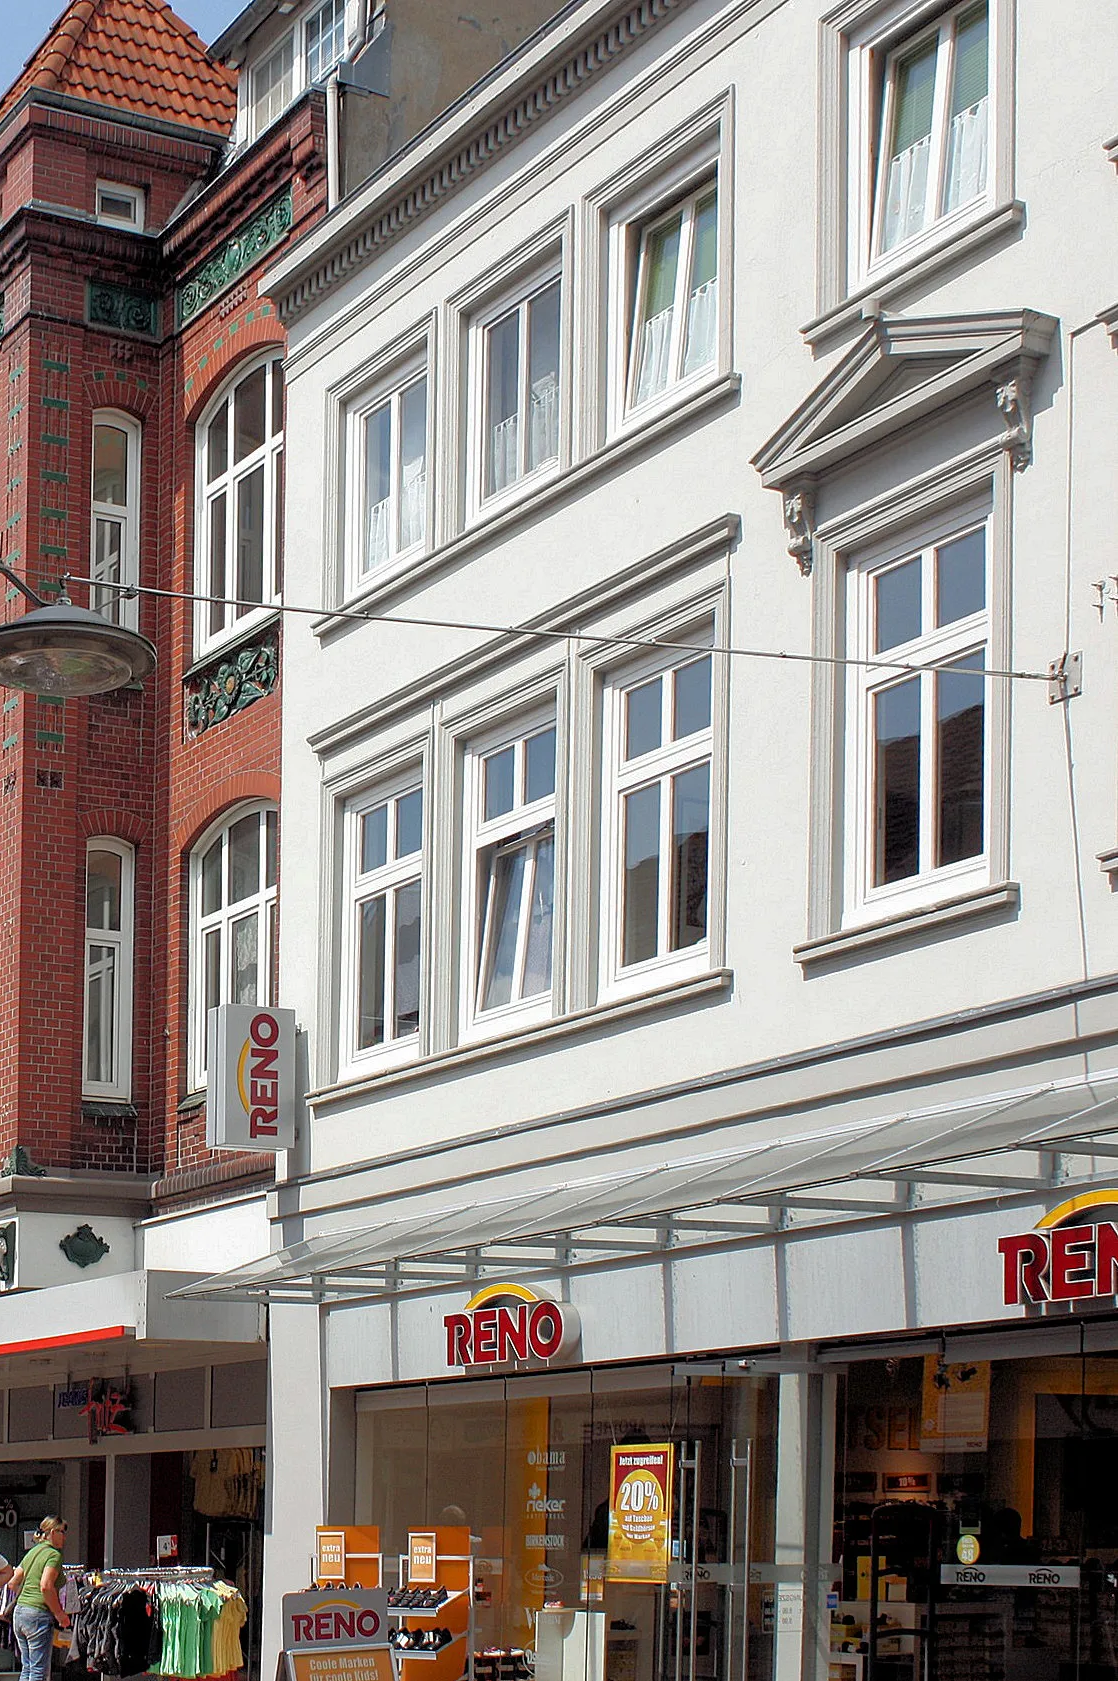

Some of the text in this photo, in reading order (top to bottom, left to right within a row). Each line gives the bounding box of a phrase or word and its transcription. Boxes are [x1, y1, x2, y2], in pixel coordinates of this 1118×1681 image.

[249, 1013, 280, 1139] RENO
[442, 1300, 564, 1367] RENO
[620, 1480, 660, 1512] 20%
[526, 1495, 566, 1513] rieker
[525, 1534, 565, 1547] BIRKENSTOCK
[321, 1544, 341, 1553] extra
[413, 1545, 432, 1554] extra
[322, 1553, 341, 1563] neu
[413, 1555, 432, 1565] neu
[955, 1571, 986, 1583] RENO
[1028, 1572, 1061, 1585] RENO
[291, 1609, 381, 1642] RENO
[309, 1656, 375, 1671] Coole Marken
[354, 1669, 379, 1681] Kids!
